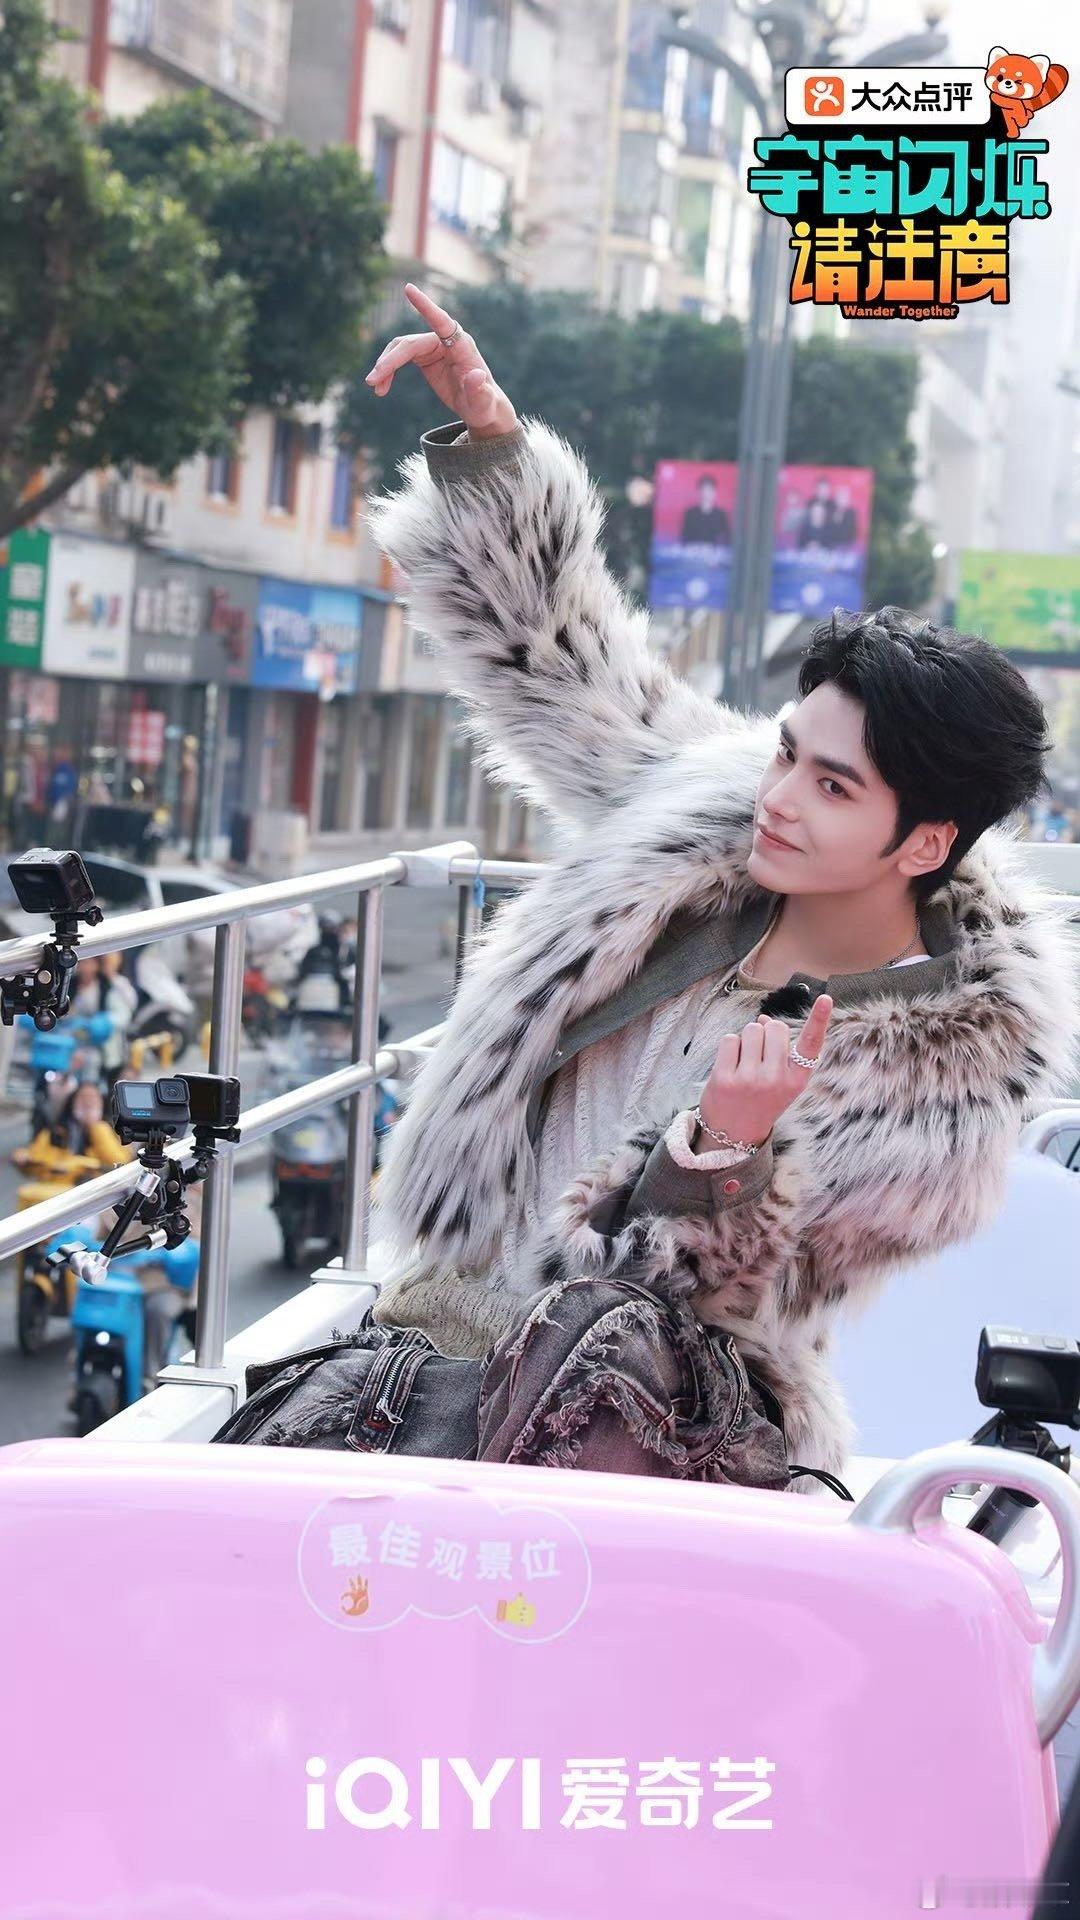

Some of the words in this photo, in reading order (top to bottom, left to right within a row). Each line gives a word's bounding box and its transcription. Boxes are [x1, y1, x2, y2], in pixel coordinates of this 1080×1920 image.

[328, 1519, 561, 1582] 最佳观景位
